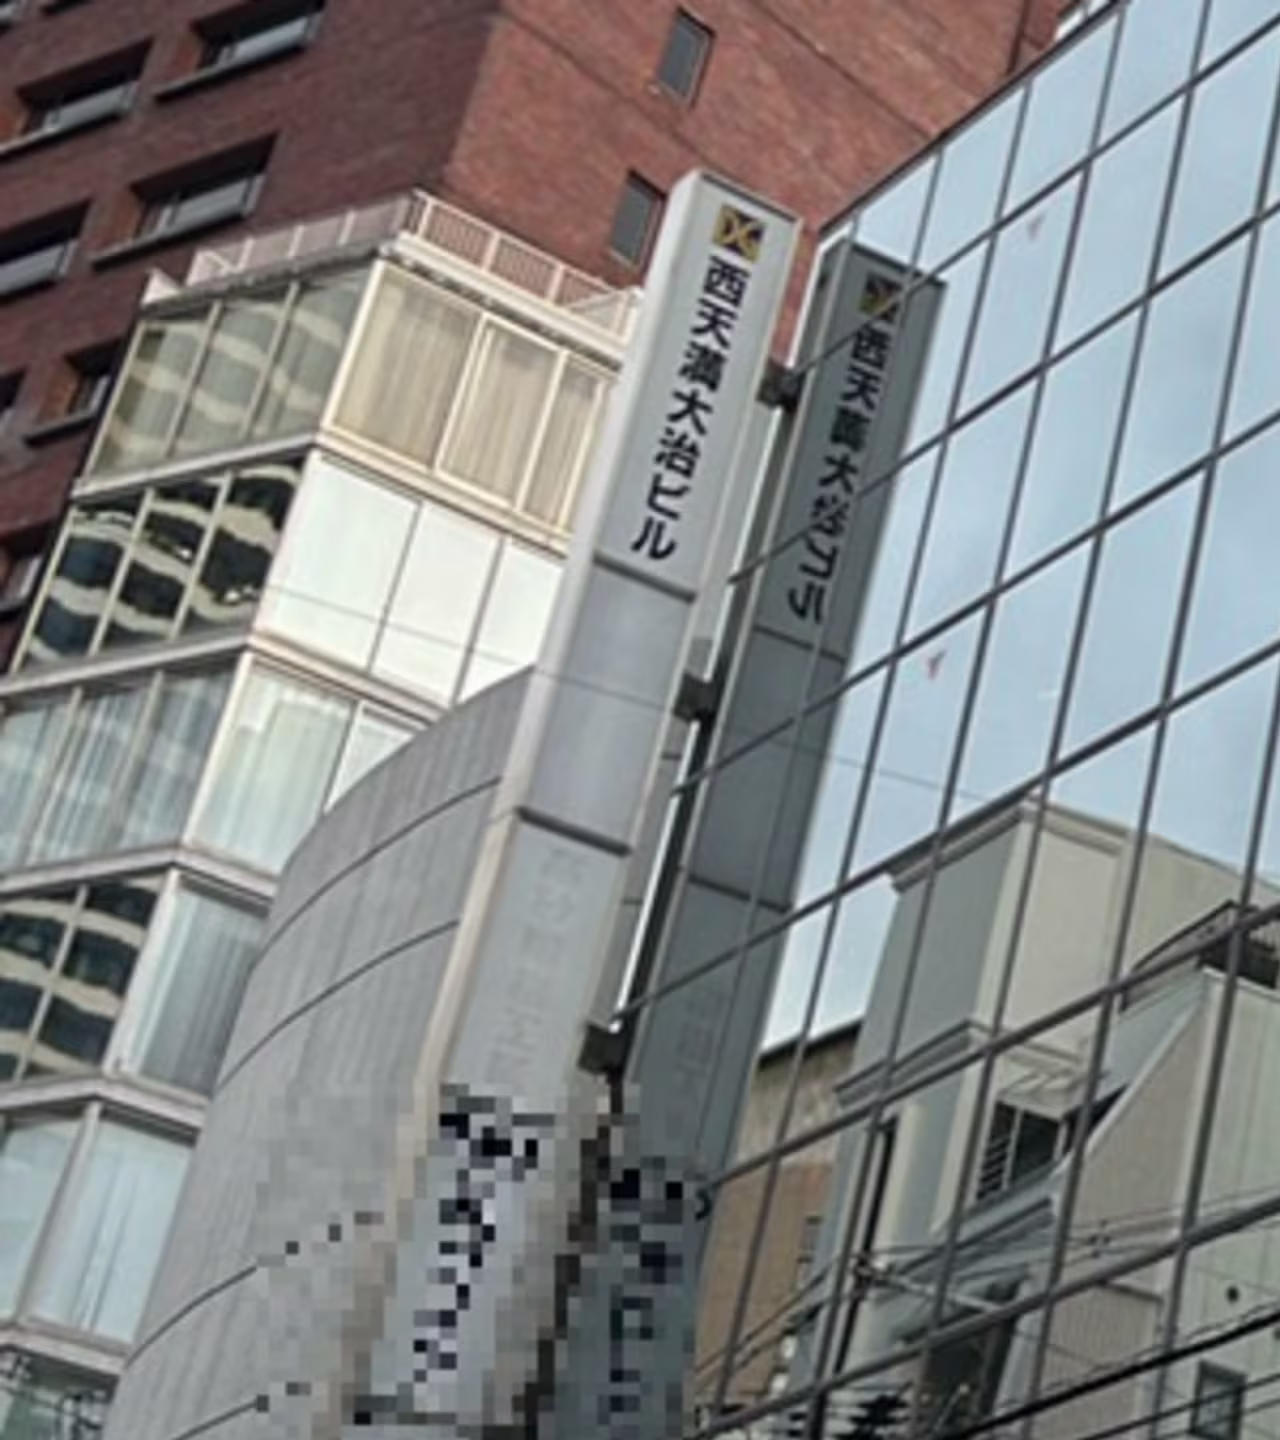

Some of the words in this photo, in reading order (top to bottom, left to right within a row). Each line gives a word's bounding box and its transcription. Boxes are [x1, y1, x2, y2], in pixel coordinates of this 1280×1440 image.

[632, 255, 749, 560] 西天満大治ビル
